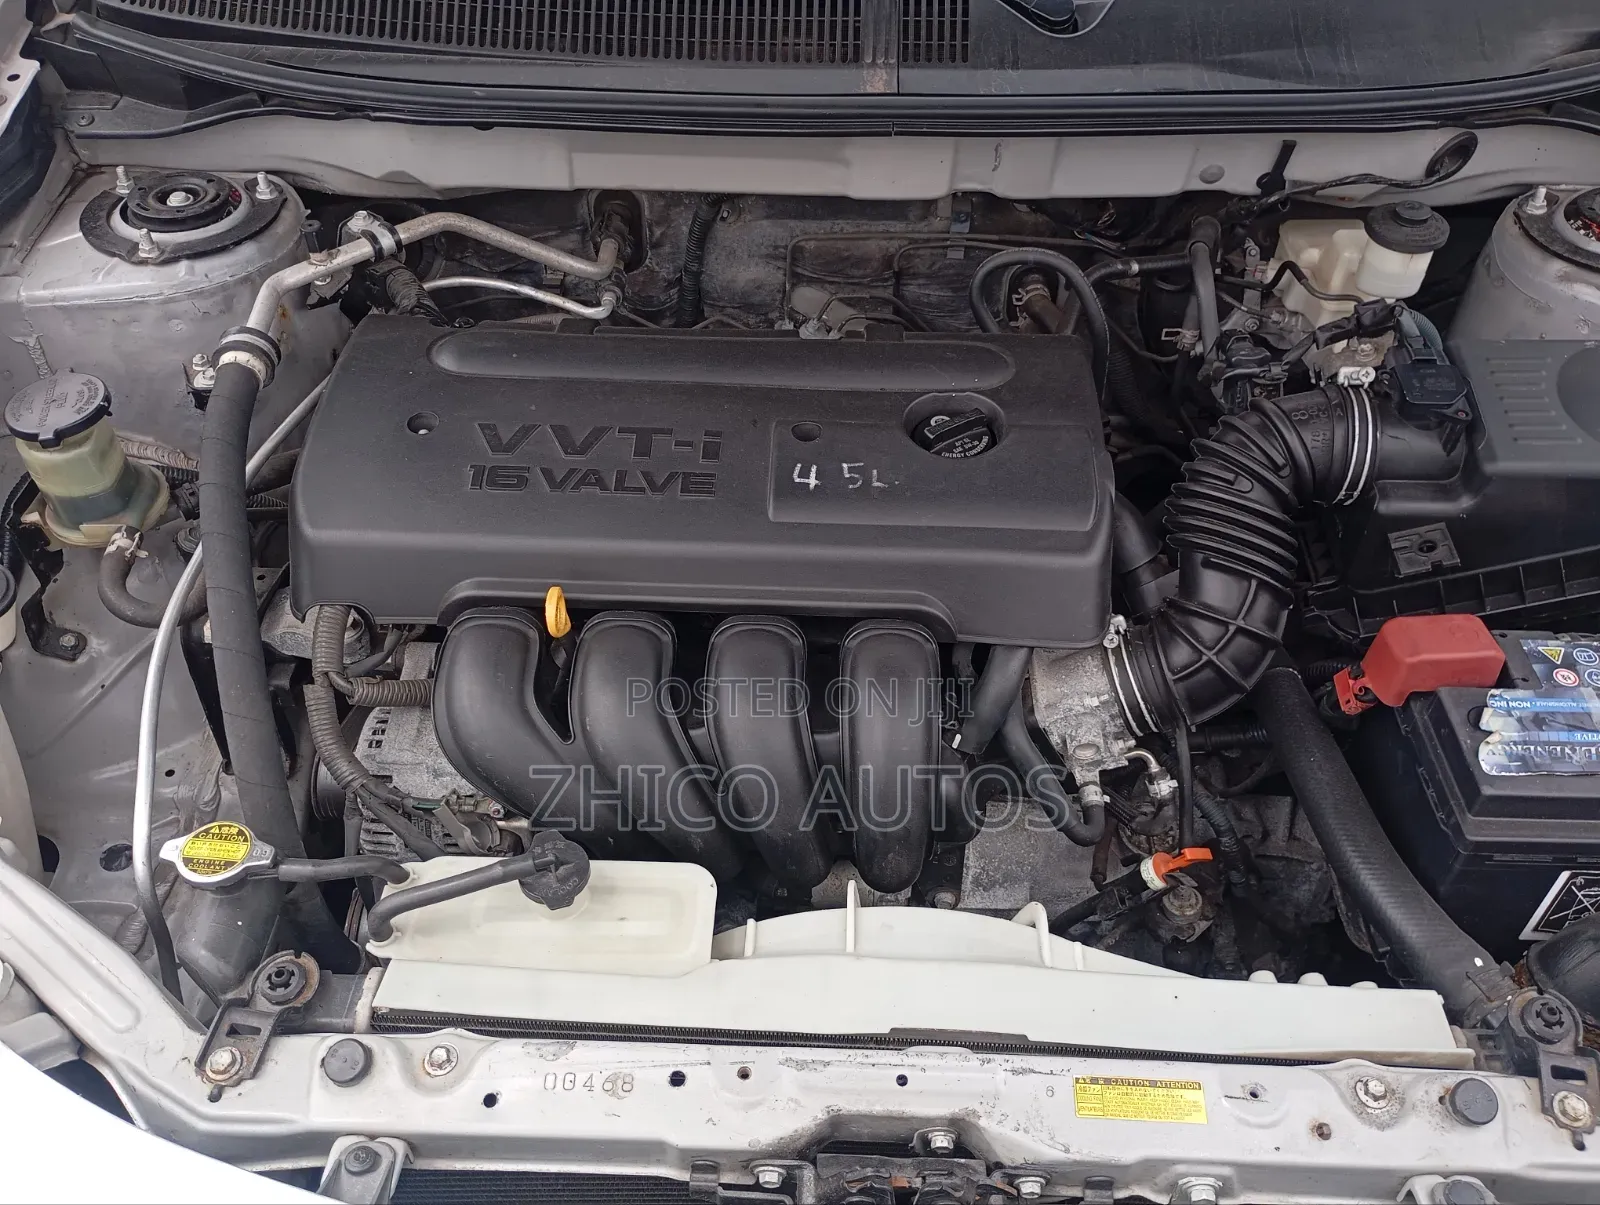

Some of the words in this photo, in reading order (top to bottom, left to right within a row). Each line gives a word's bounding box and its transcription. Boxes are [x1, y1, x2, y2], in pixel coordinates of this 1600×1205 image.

[475, 422, 723, 463] VVT-i
[468, 464, 530, 492] 16
[537, 466, 718, 497] VALVE
[793, 463, 821, 491] 4
[1508, 700, 1531, 708] NON
[199, 832, 245, 843] CAUTION
[193, 858, 226, 866] ENGINE
[543, 1072, 634, 1093] 00468
[1110, 1078, 1151, 1087] CAUTION
[1156, 1080, 1200, 1090] ATTENTION
